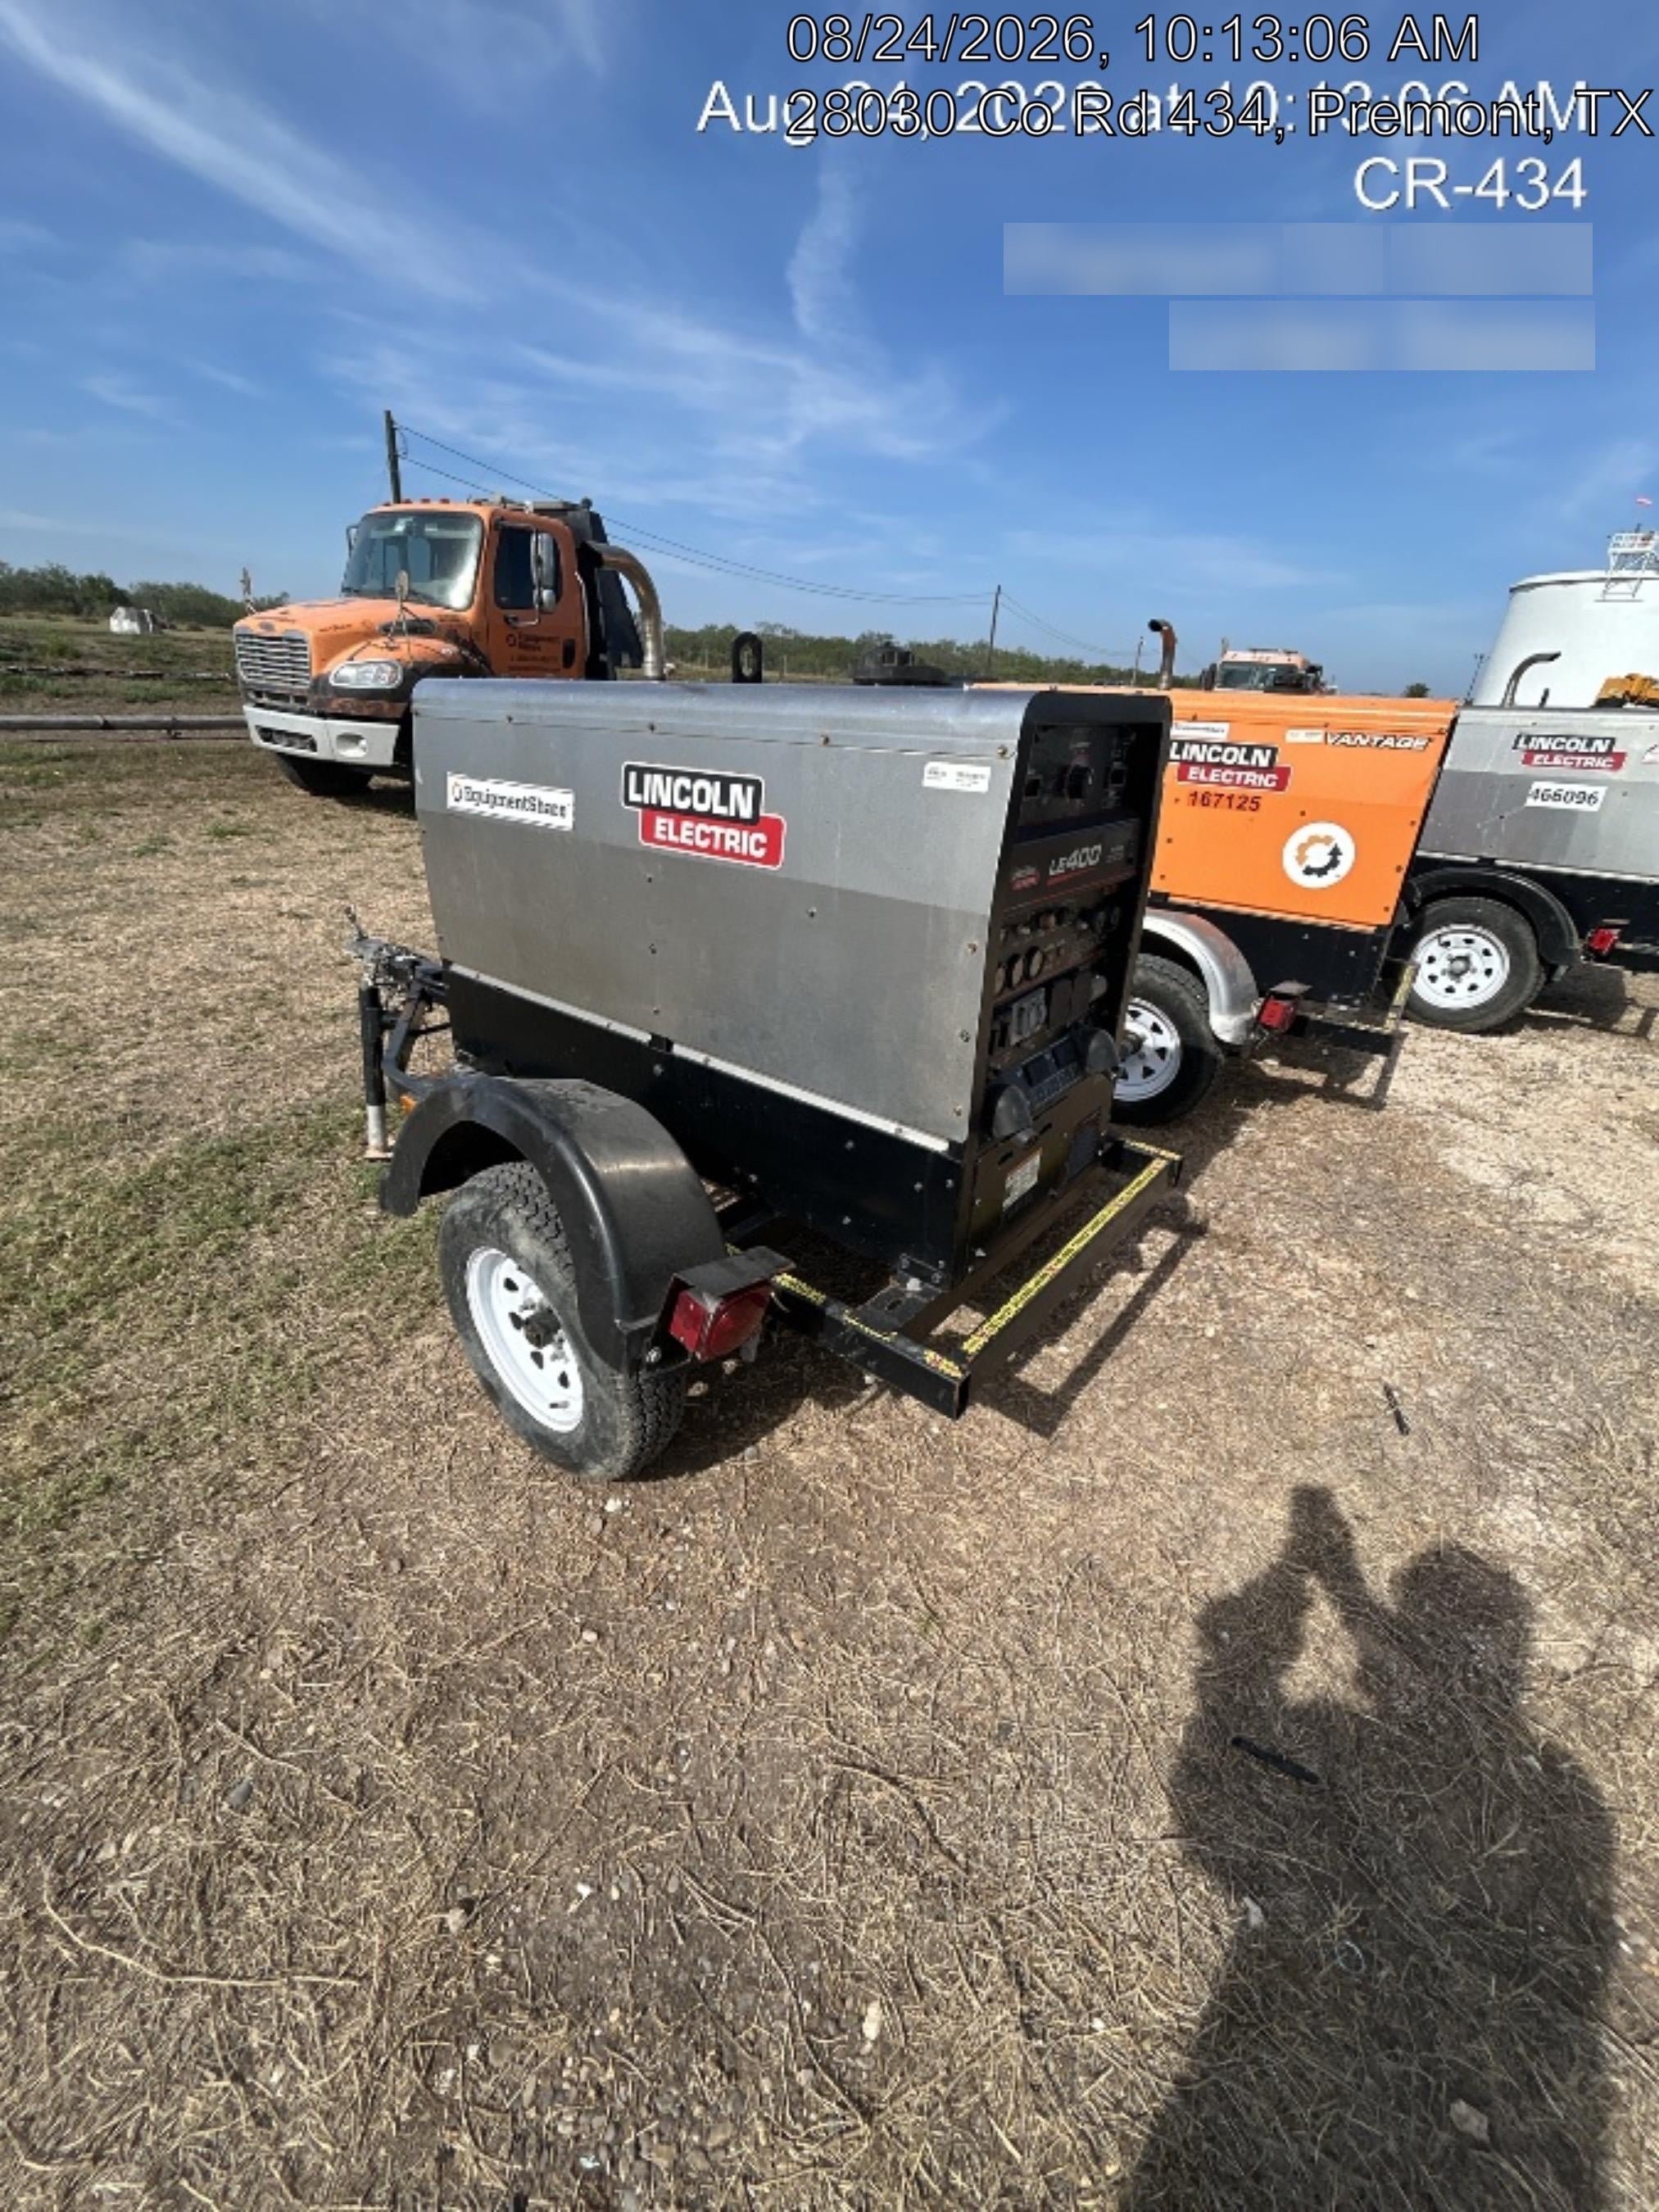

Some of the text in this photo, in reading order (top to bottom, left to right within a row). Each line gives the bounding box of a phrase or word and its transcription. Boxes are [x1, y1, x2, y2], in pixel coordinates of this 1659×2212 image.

[1326, 732, 1430, 750] VANTAGE
[1518, 735, 1611, 752] LINCOLN
[1169, 741, 1271, 768] LINCOLN
[1532, 753, 1615, 768] ELECTRIC
[1188, 766, 1279, 787] ELECTRIC
[628, 771, 755, 819] LINCOLN
[1190, 791, 1262, 812] 167125
[655, 817, 768, 859] ELECTRIC
